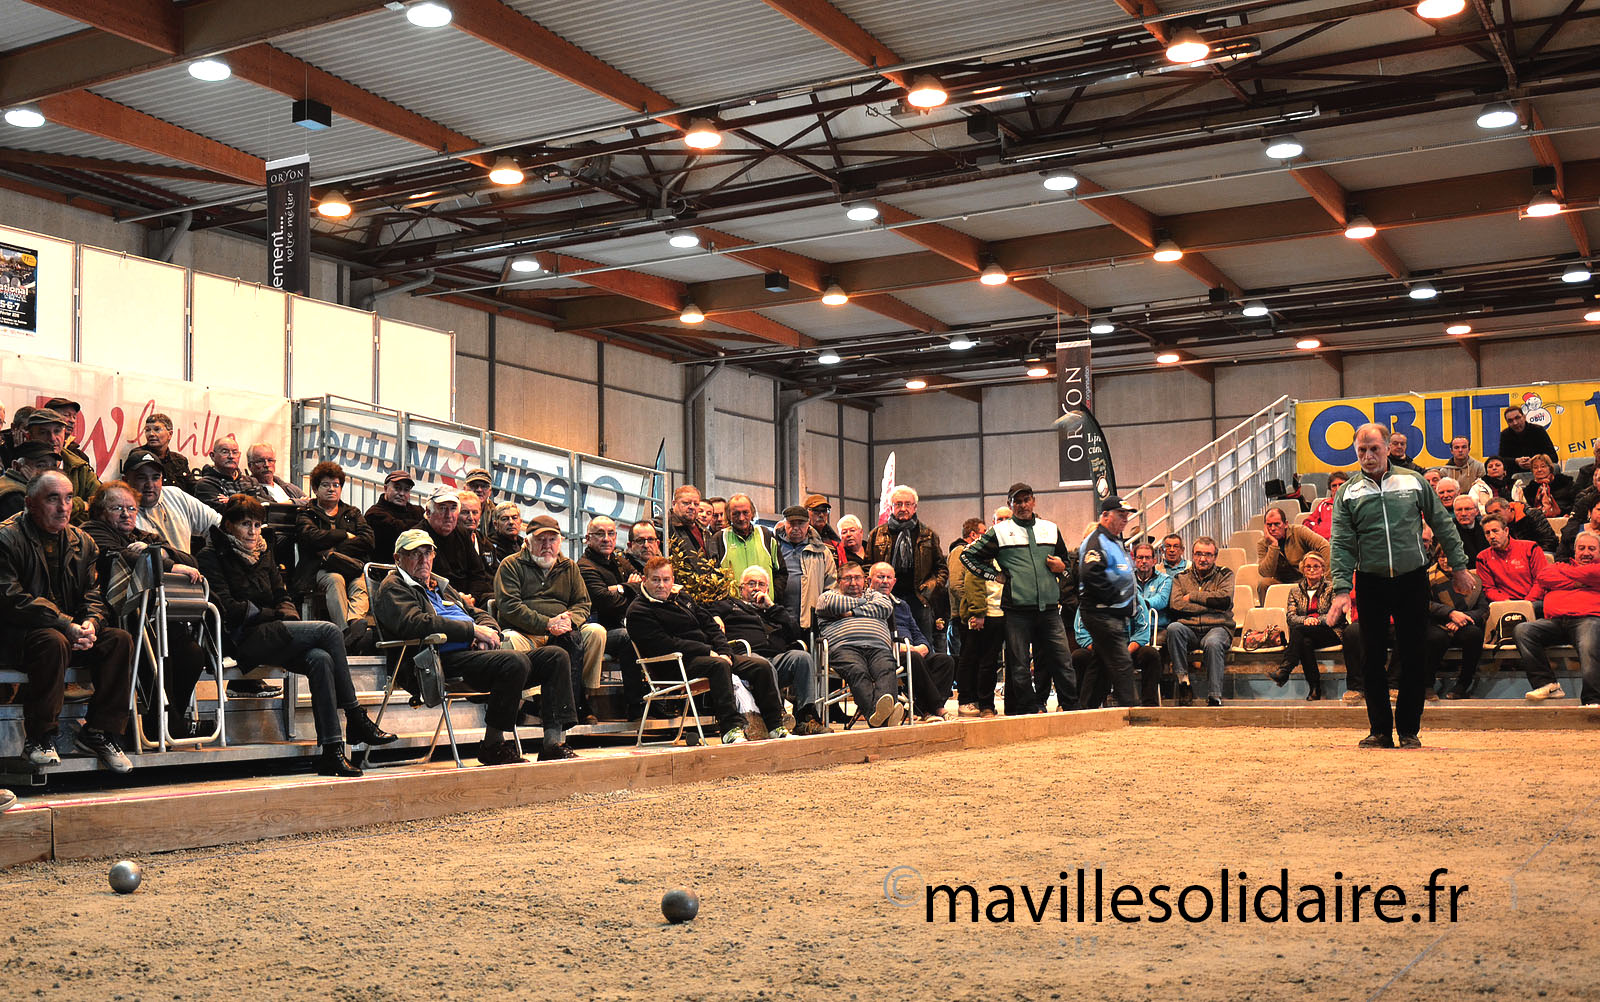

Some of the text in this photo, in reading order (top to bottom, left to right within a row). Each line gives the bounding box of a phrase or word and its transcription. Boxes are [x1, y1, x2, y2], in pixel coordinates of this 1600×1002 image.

[270, 169, 304, 184] ORYON
[271, 216, 284, 290] ement...
[284, 190, 296, 262] notre métier
[1308, 393, 1510, 467] OBUT
[1568, 440, 1587, 453] EN
